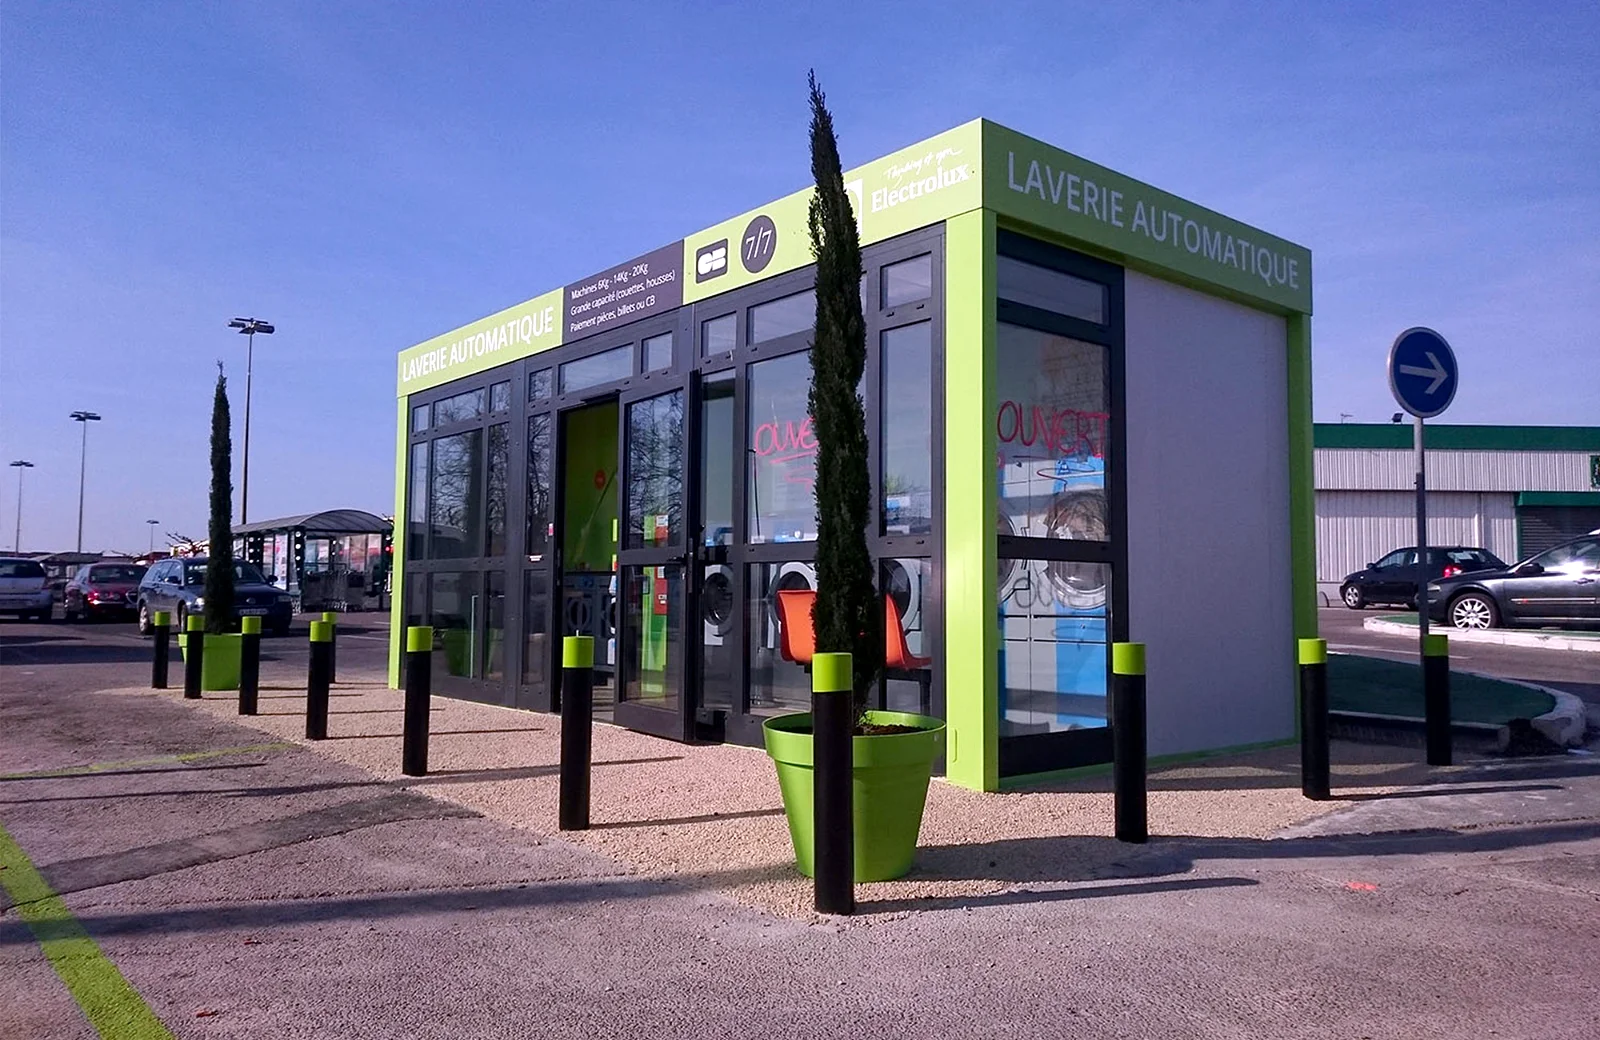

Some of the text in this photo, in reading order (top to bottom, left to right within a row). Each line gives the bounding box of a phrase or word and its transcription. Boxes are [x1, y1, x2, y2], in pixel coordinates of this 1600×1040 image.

[871, 164, 970, 213] Electrolux
[745, 227, 773, 261] 7/7
[1007, 151, 1299, 290] LAVERIE AUTOMATIQUE
[570, 301, 592, 316] Grande
[592, 291, 615, 309] capacité
[646, 269, 676, 289] housses)
[571, 283, 597, 300] Machines
[597, 278, 609, 290] 6Kg
[613, 270, 628, 284] 14Kg
[632, 263, 649, 277] 20Kg
[570, 316, 597, 333] Paiement
[617, 303, 636, 317] billets
[636, 299, 645, 310] ou
[645, 294, 656, 307] CB
[402, 306, 554, 382] LAVERIE AUTOMATIQUE
[754, 416, 820, 456] OUVE
[997, 400, 1110, 458] OUVERT
